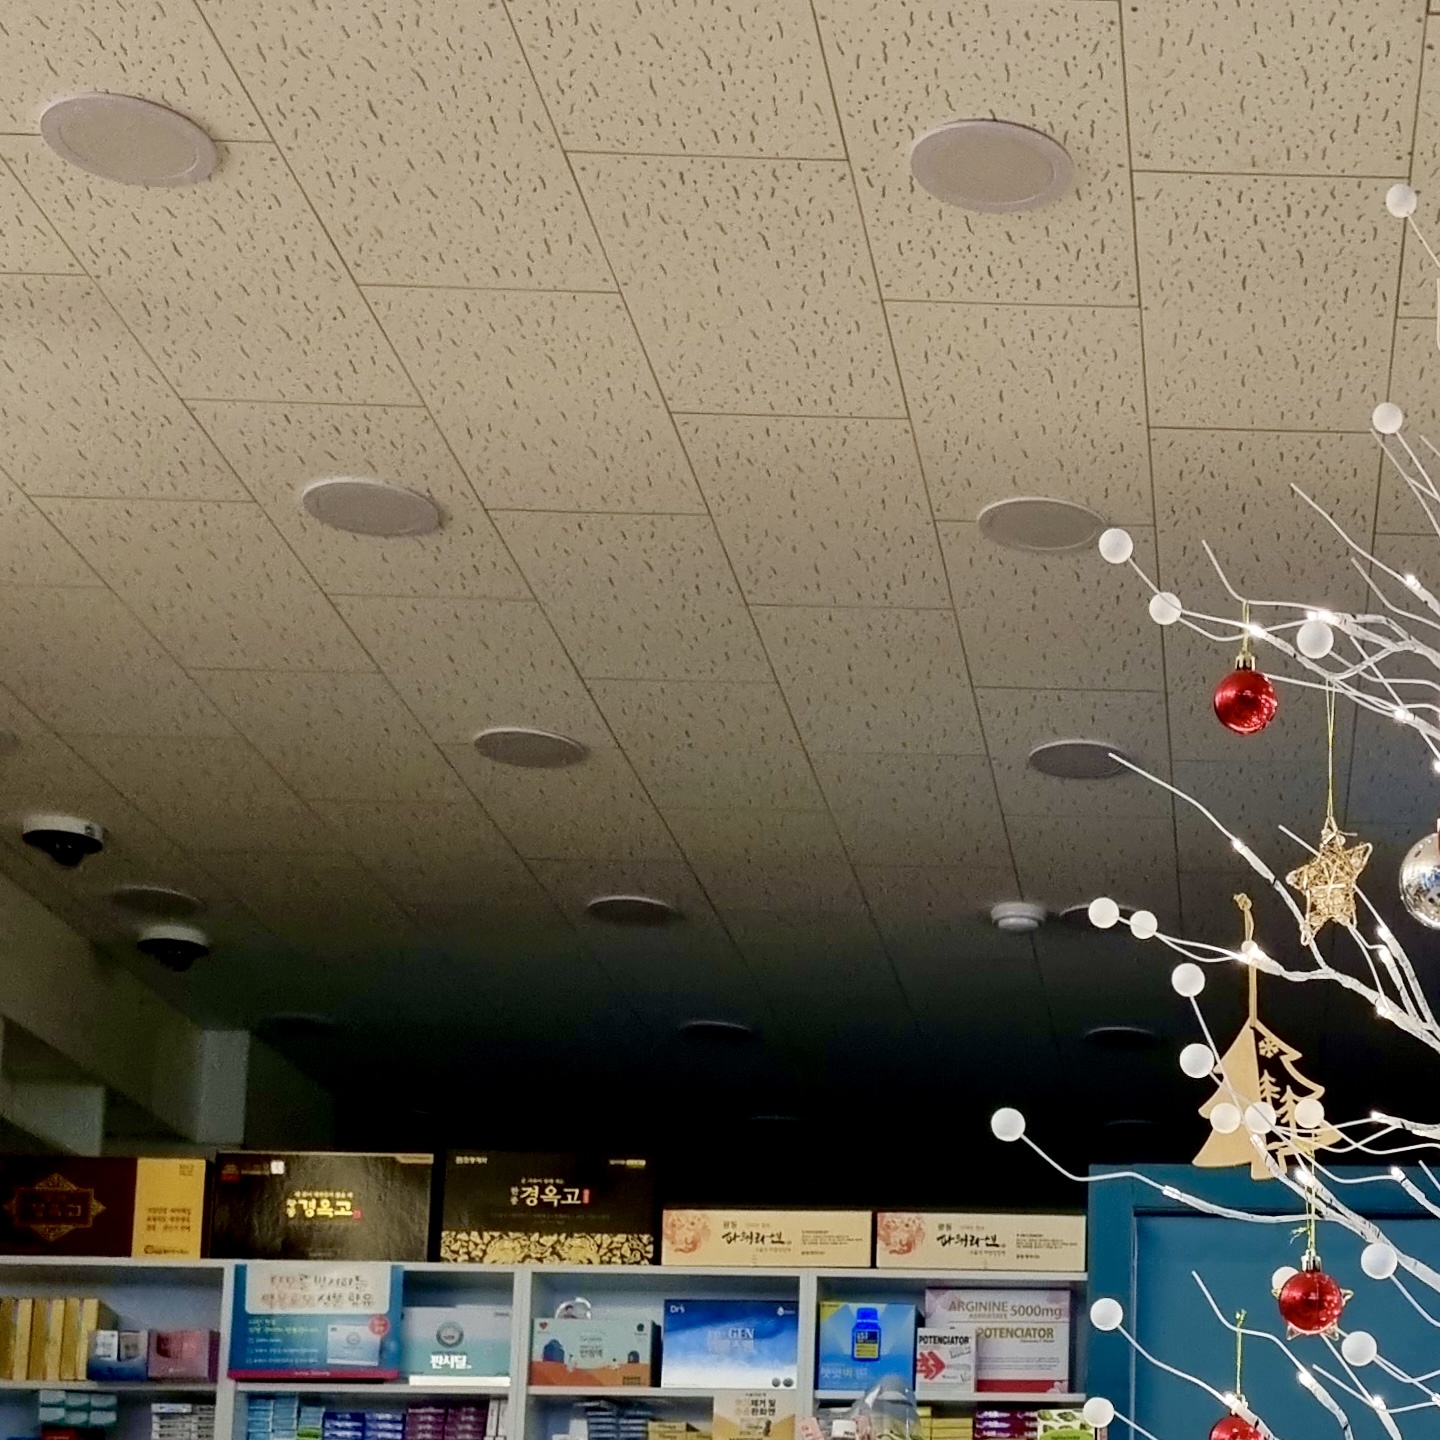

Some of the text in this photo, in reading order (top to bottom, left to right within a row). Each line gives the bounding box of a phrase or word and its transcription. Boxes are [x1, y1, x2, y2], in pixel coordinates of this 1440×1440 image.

[520, 1185, 582, 1207] 경옥고
[949, 1300, 1062, 1319] ARGININE 5000mg
[918, 1335, 970, 1346] POTENCIATOR
[976, 1327, 1054, 1339] POTENCIATOR
